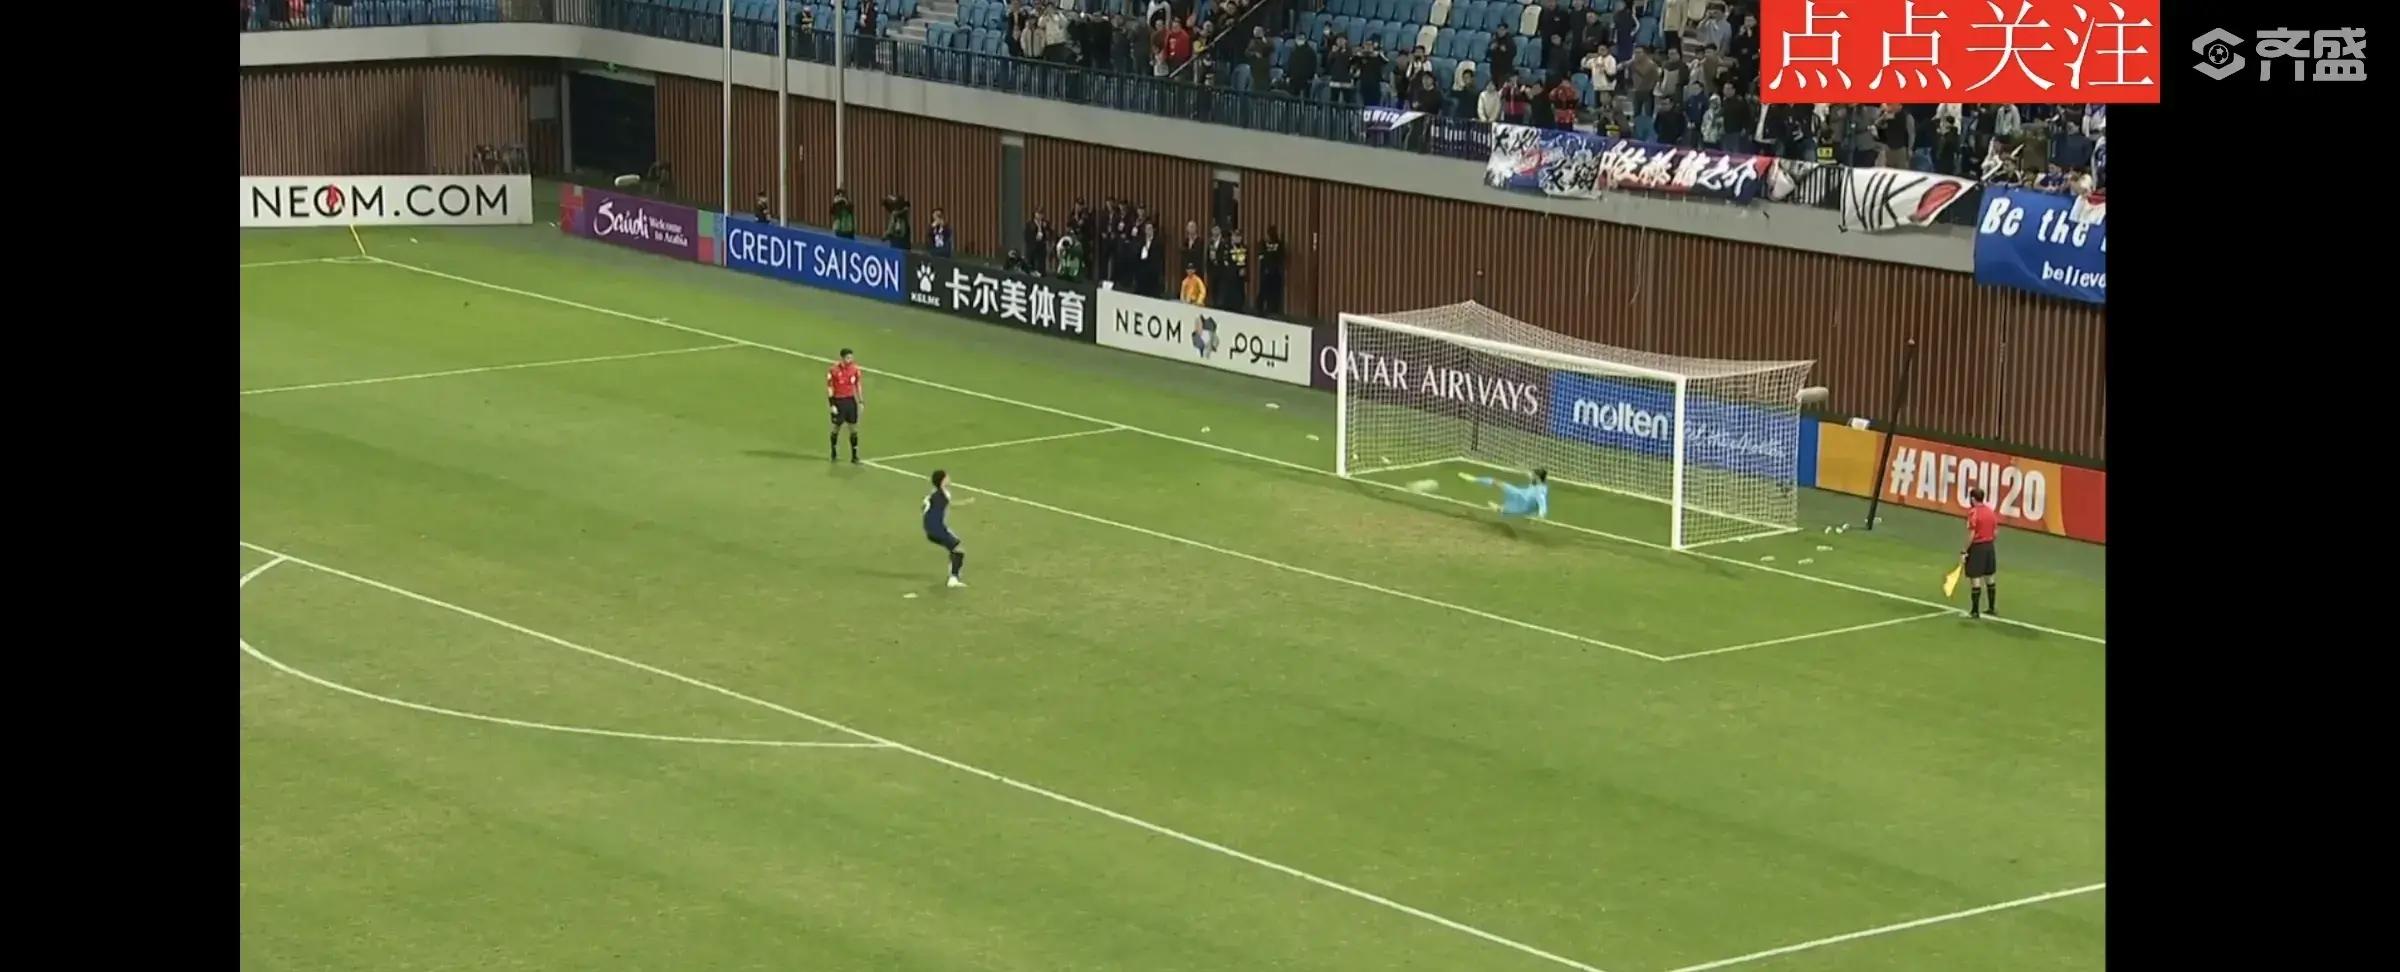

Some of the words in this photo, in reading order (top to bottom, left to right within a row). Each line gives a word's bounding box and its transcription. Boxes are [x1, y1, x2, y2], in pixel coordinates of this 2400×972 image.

[252, 184, 507, 218] NEOM.COM
[593, 198, 650, 239] Saudi
[1980, 197, 2024, 236] Be
[2037, 208, 2090, 247] the
[729, 228, 806, 272] CREDIT
[813, 245, 899, 292] SAISON
[910, 292, 941, 307] KELME
[945, 267, 1086, 333] 卡尔美体育
[1115, 308, 1182, 344] NEOM
[1229, 333, 1289, 367] نيوم
[1320, 345, 1409, 390] QATAR
[1421, 363, 1539, 415] AIRWAYS
[1573, 398, 1669, 440] molten
[1889, 446, 2046, 521] #AFCU20
